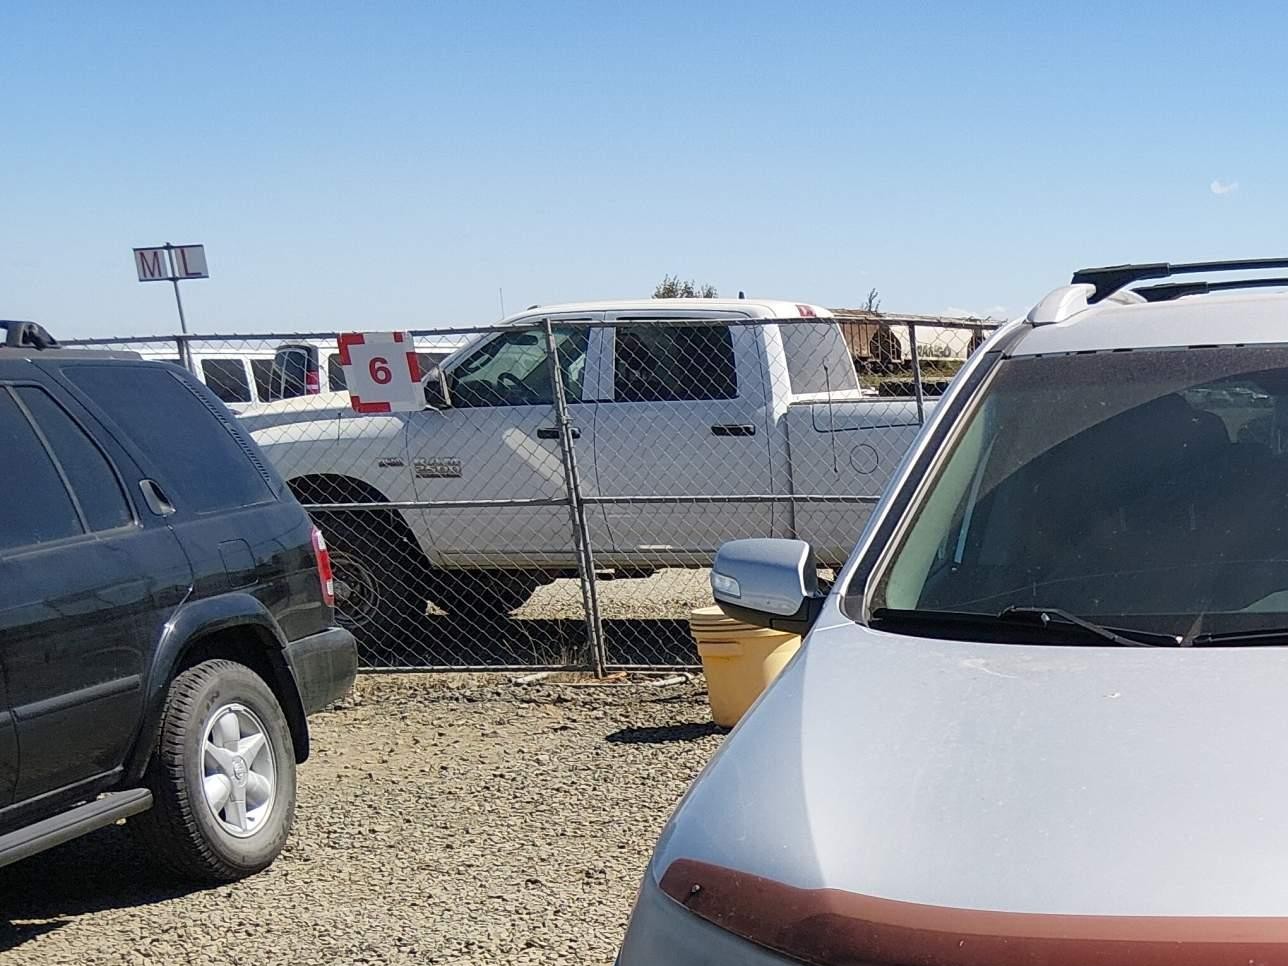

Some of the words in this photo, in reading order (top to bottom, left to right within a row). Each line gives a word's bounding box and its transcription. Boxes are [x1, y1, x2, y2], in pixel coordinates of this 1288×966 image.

[139, 251, 162, 278] M
[180, 249, 202, 276] L
[369, 357, 393, 385] 6
